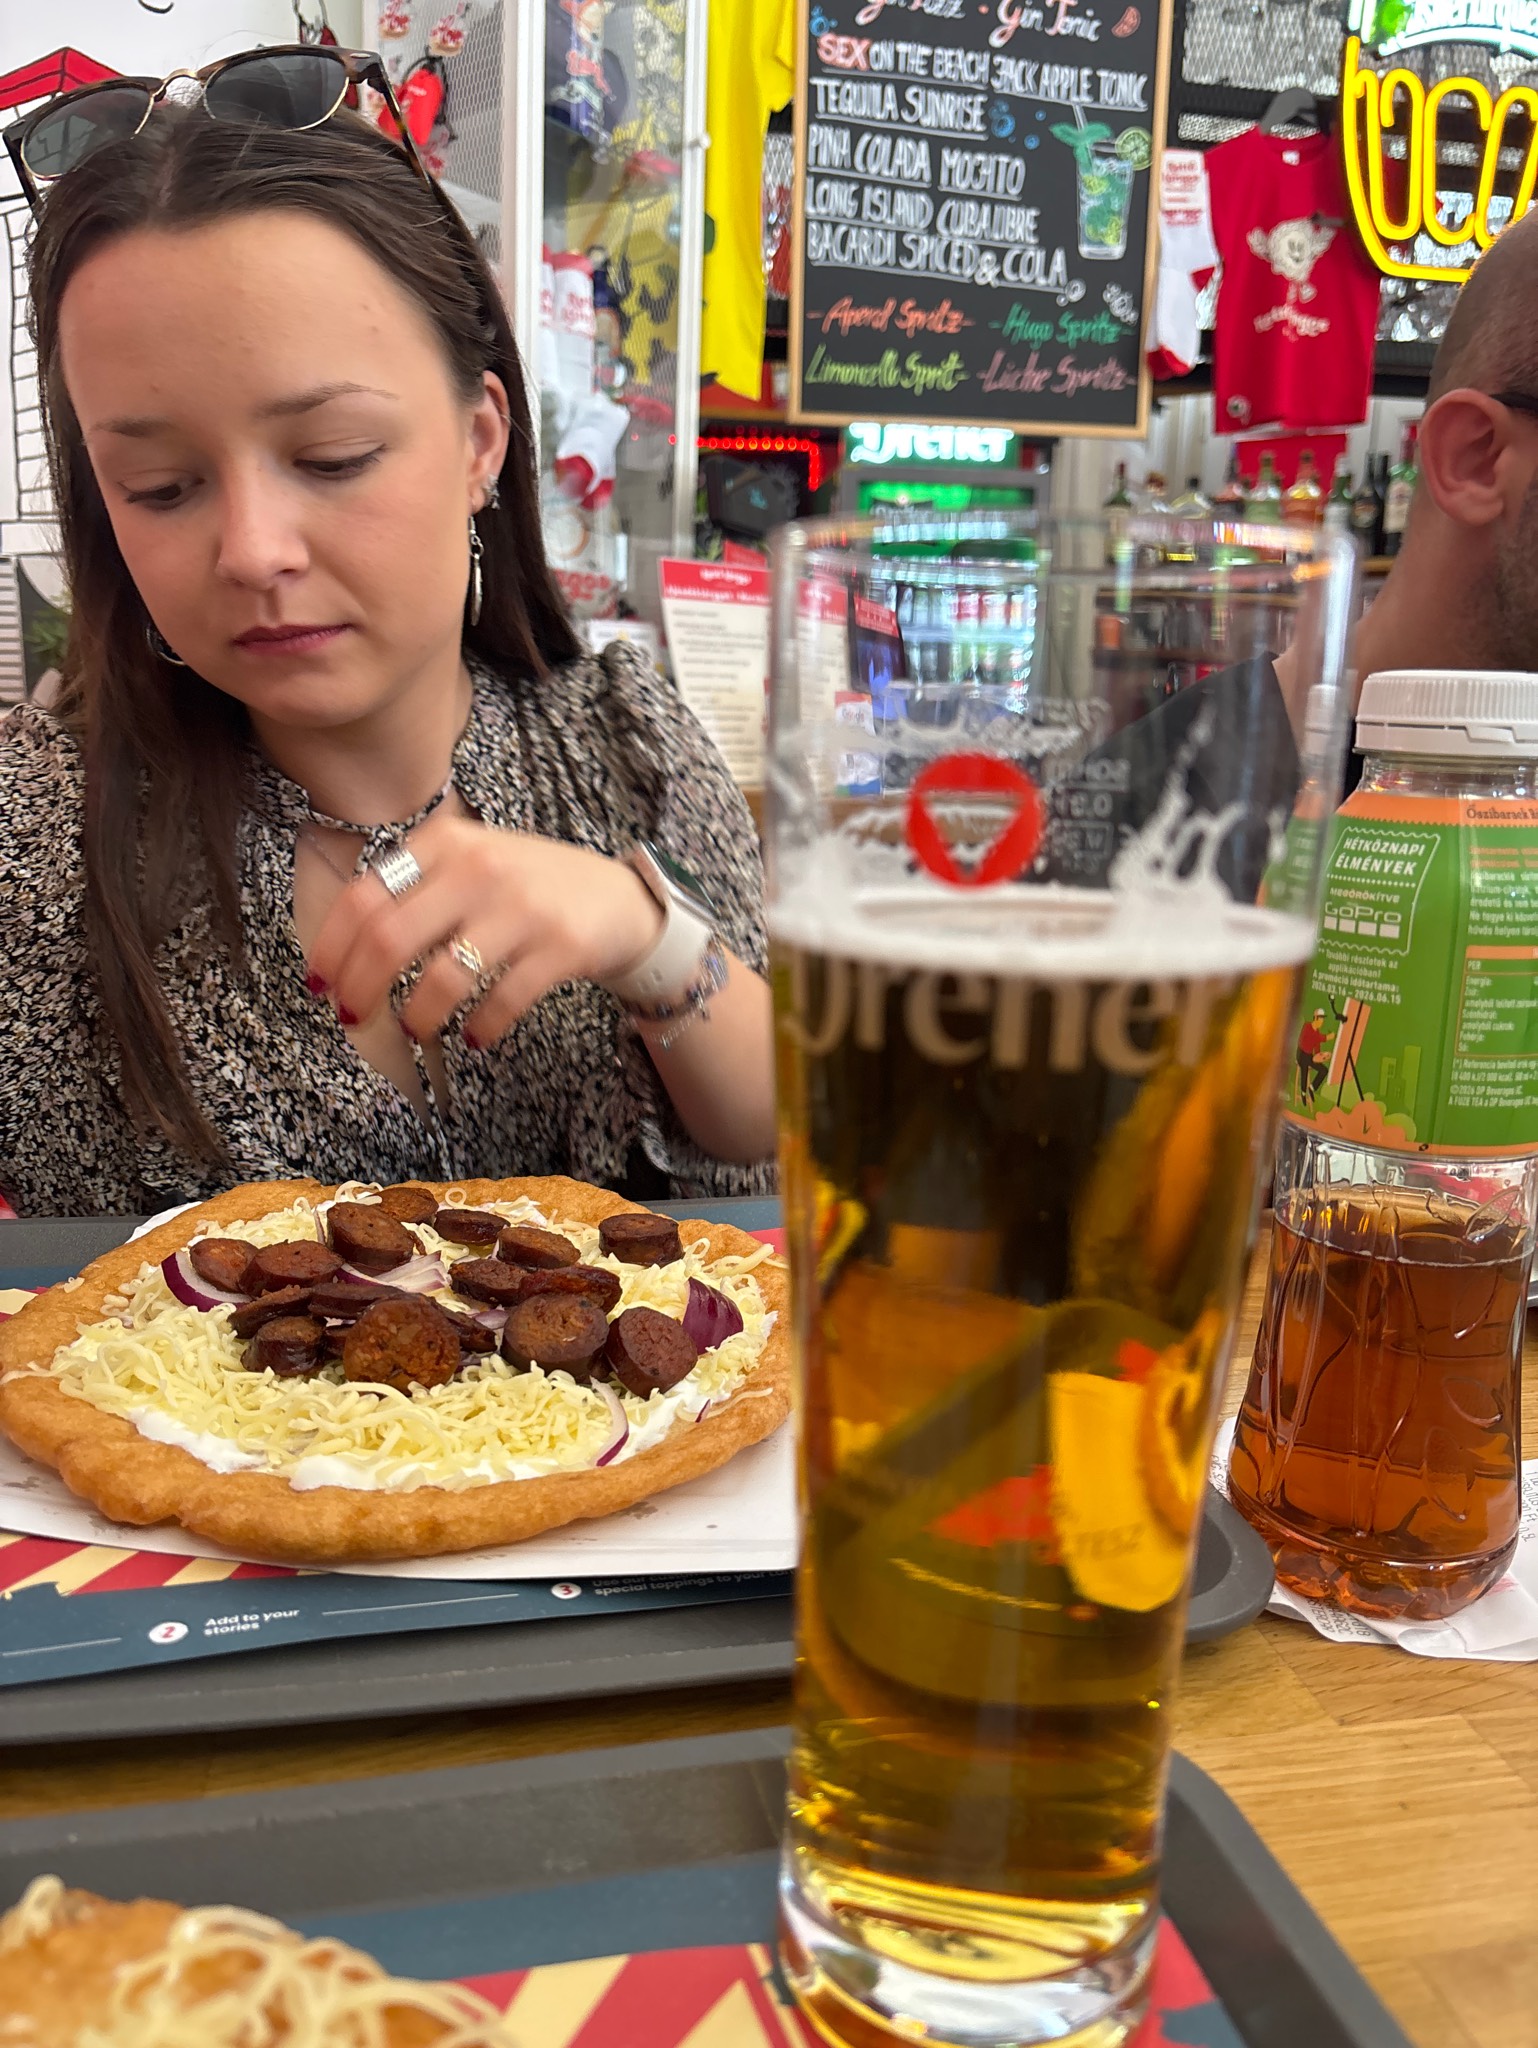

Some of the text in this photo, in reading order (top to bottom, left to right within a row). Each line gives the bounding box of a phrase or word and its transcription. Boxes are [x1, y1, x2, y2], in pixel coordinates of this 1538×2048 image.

[817, 32, 991, 84] SEX ON THE BEACH
[990, 54, 1149, 108] JACK APPLE TONIC
[809, 76, 989, 132] TEQUILA SUNRISE
[854, 131, 932, 183] COLADA
[805, 176, 859, 218] LONG
[861, 186, 935, 230] ISLAND
[807, 220, 897, 267] BACARDI
[899, 233, 981, 278] SPICED
[1002, 246, 1068, 287] COLA
[1343, 836, 1426, 857] HÉTKÖZNAPI
[1334, 852, 1418, 876] ÉLMÉNYEK
[1324, 901, 1402, 924] GoPro
[560, 1584, 574, 1596] 3
[595, 1582, 648, 1597] special
[650, 1575, 715, 1592] toppings
[716, 1574, 732, 1584] to
[733, 1571, 767, 1586] your
[160, 1609, 300, 1639] 2 Add to your
[203, 1621, 261, 1637] stories
